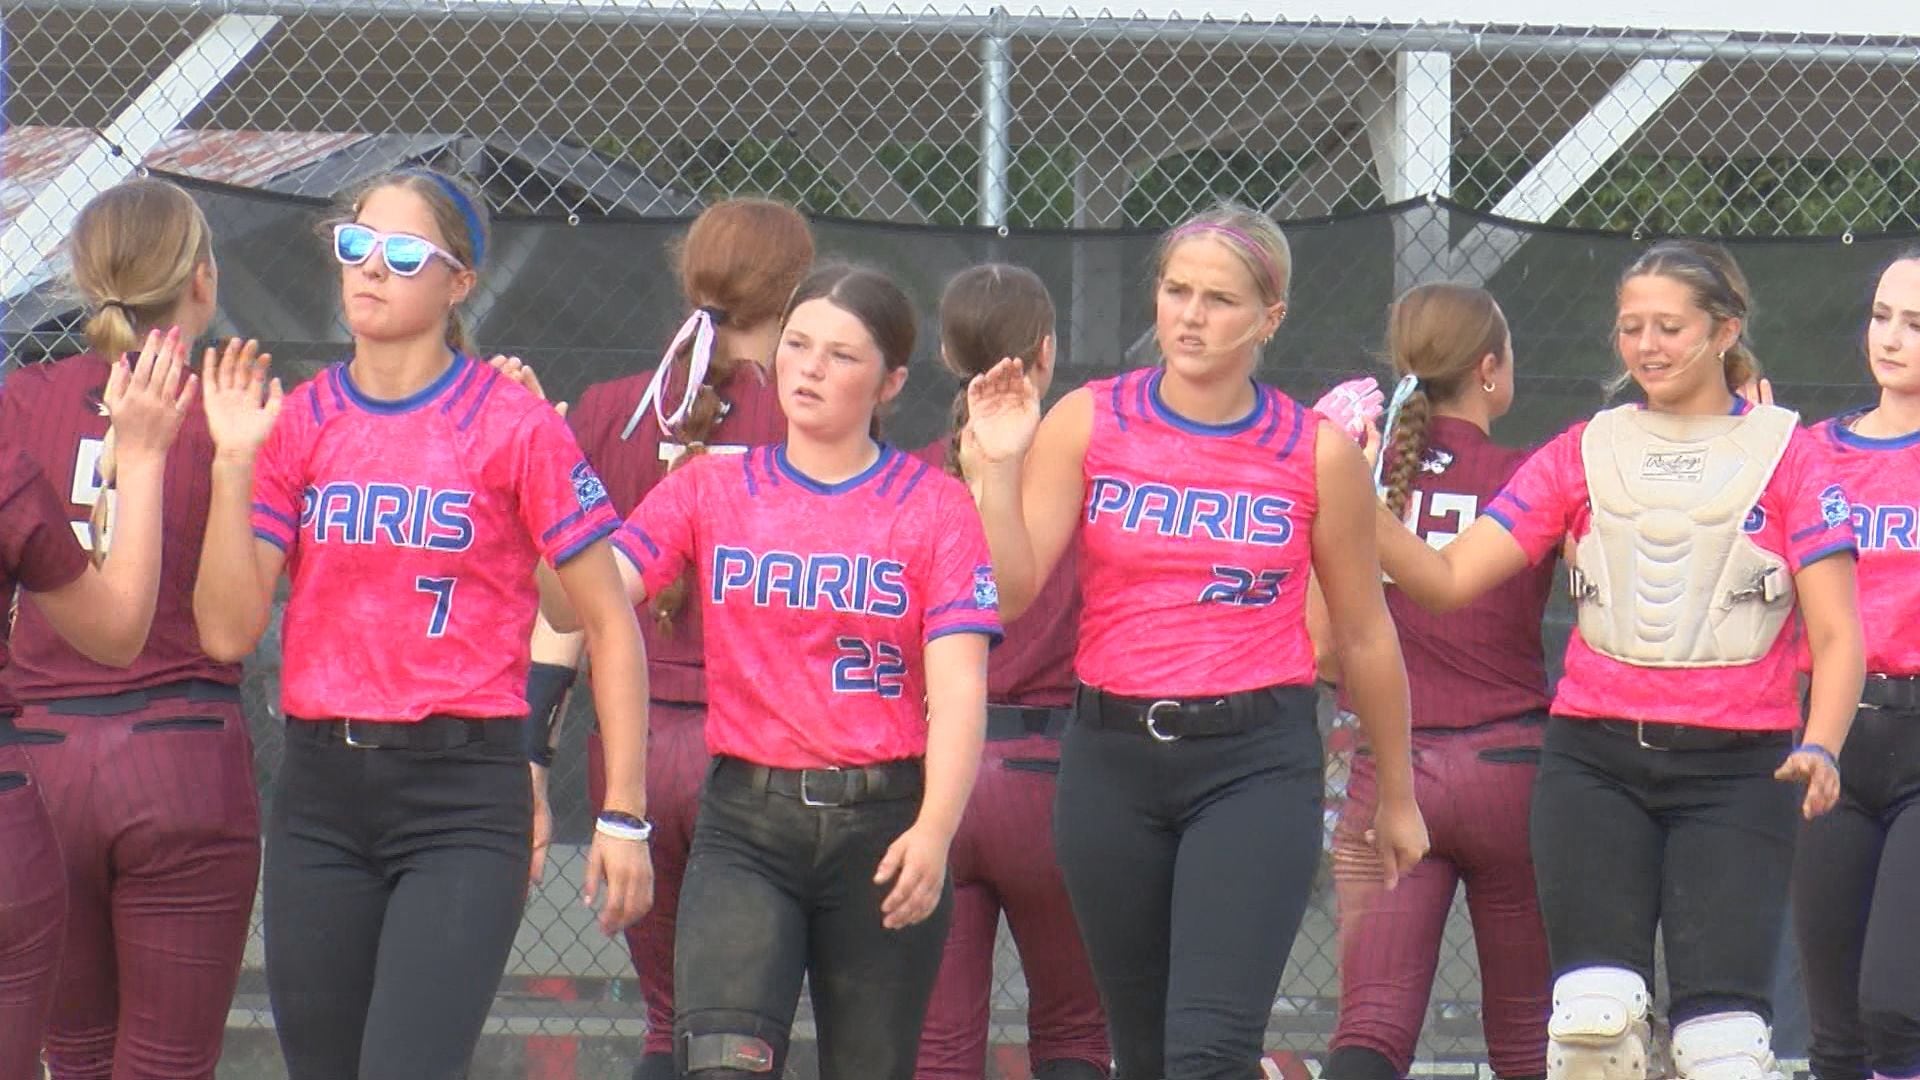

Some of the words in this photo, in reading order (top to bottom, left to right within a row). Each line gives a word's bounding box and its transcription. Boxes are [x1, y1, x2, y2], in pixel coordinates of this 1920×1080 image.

[1088, 475, 1296, 546] PARIS
[416, 576, 457, 638] 7
[712, 544, 909, 618] PARIS
[1197, 565, 1294, 606] 23
[832, 637, 908, 697] 22
